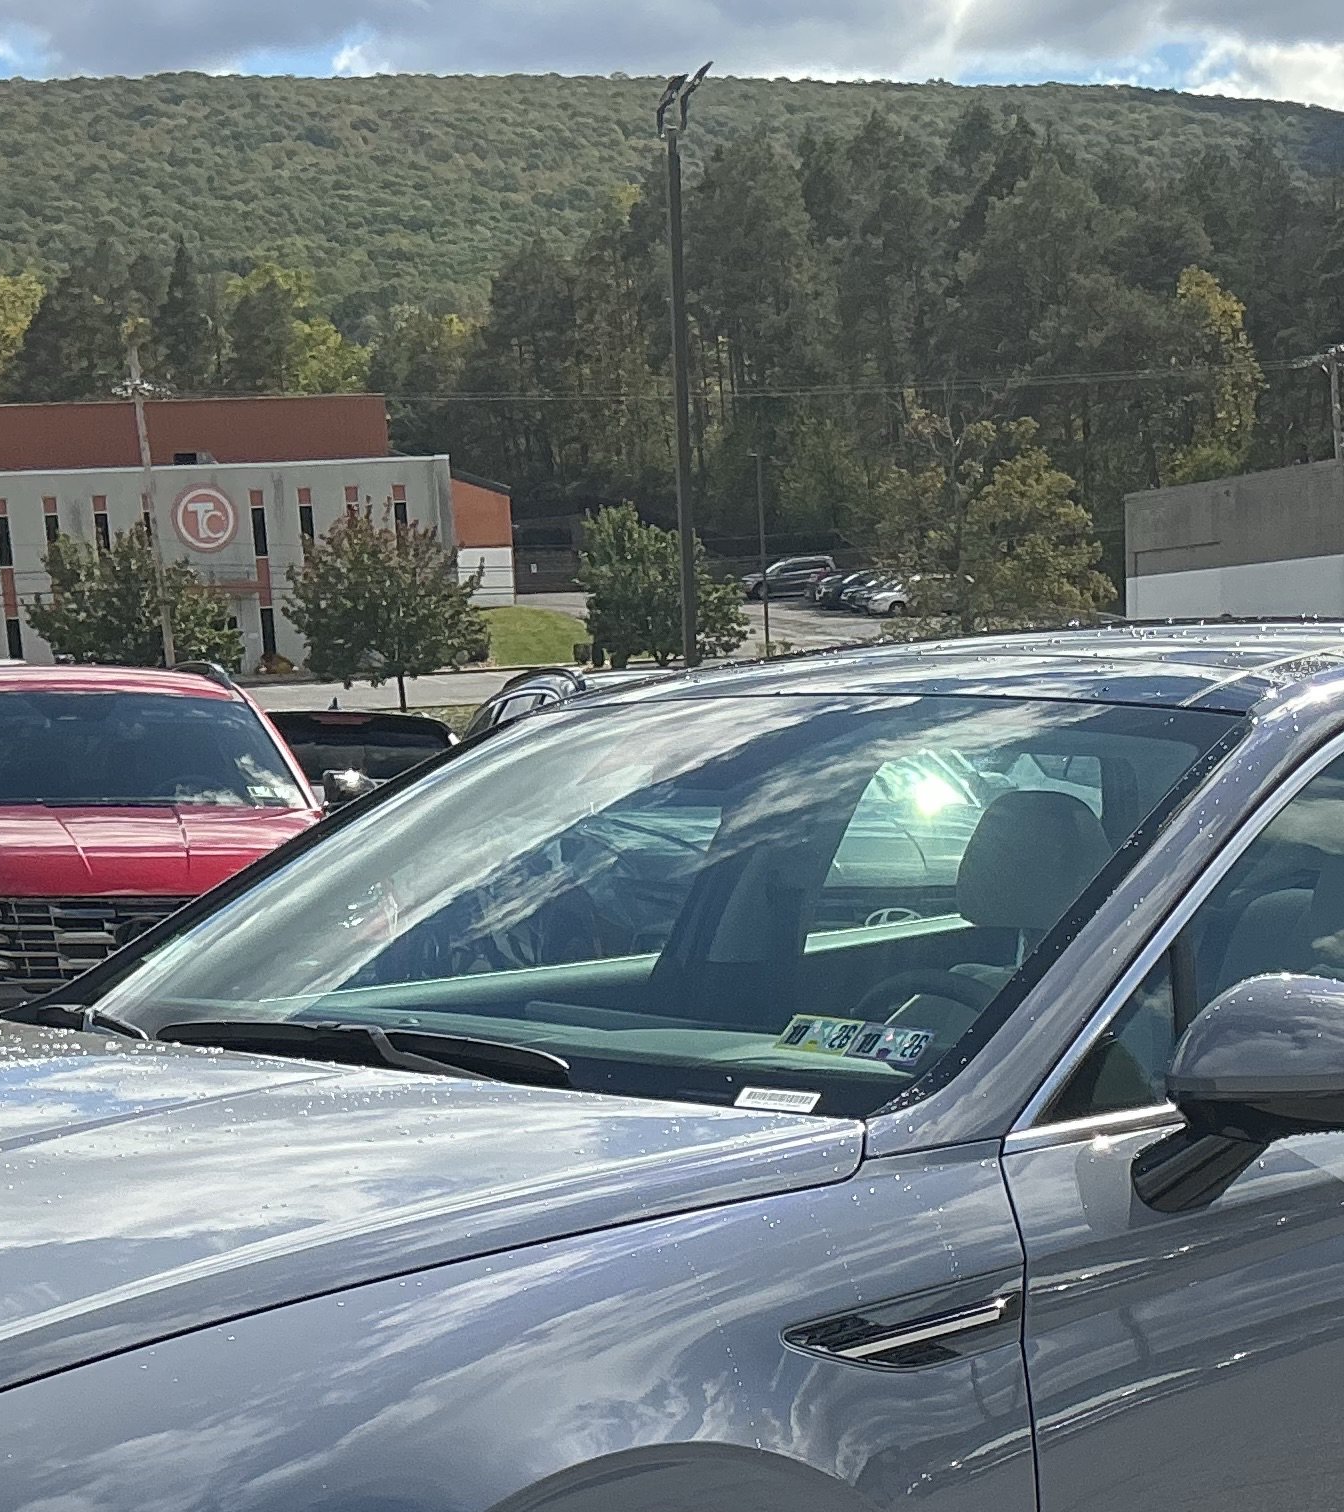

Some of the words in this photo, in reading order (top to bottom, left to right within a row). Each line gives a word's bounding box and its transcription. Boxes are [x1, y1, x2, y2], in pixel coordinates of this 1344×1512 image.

[785, 1024, 810, 1045] 10
[828, 1025, 858, 1048] 26
[857, 1033, 882, 1053] 10
[900, 1034, 929, 1058] 26
